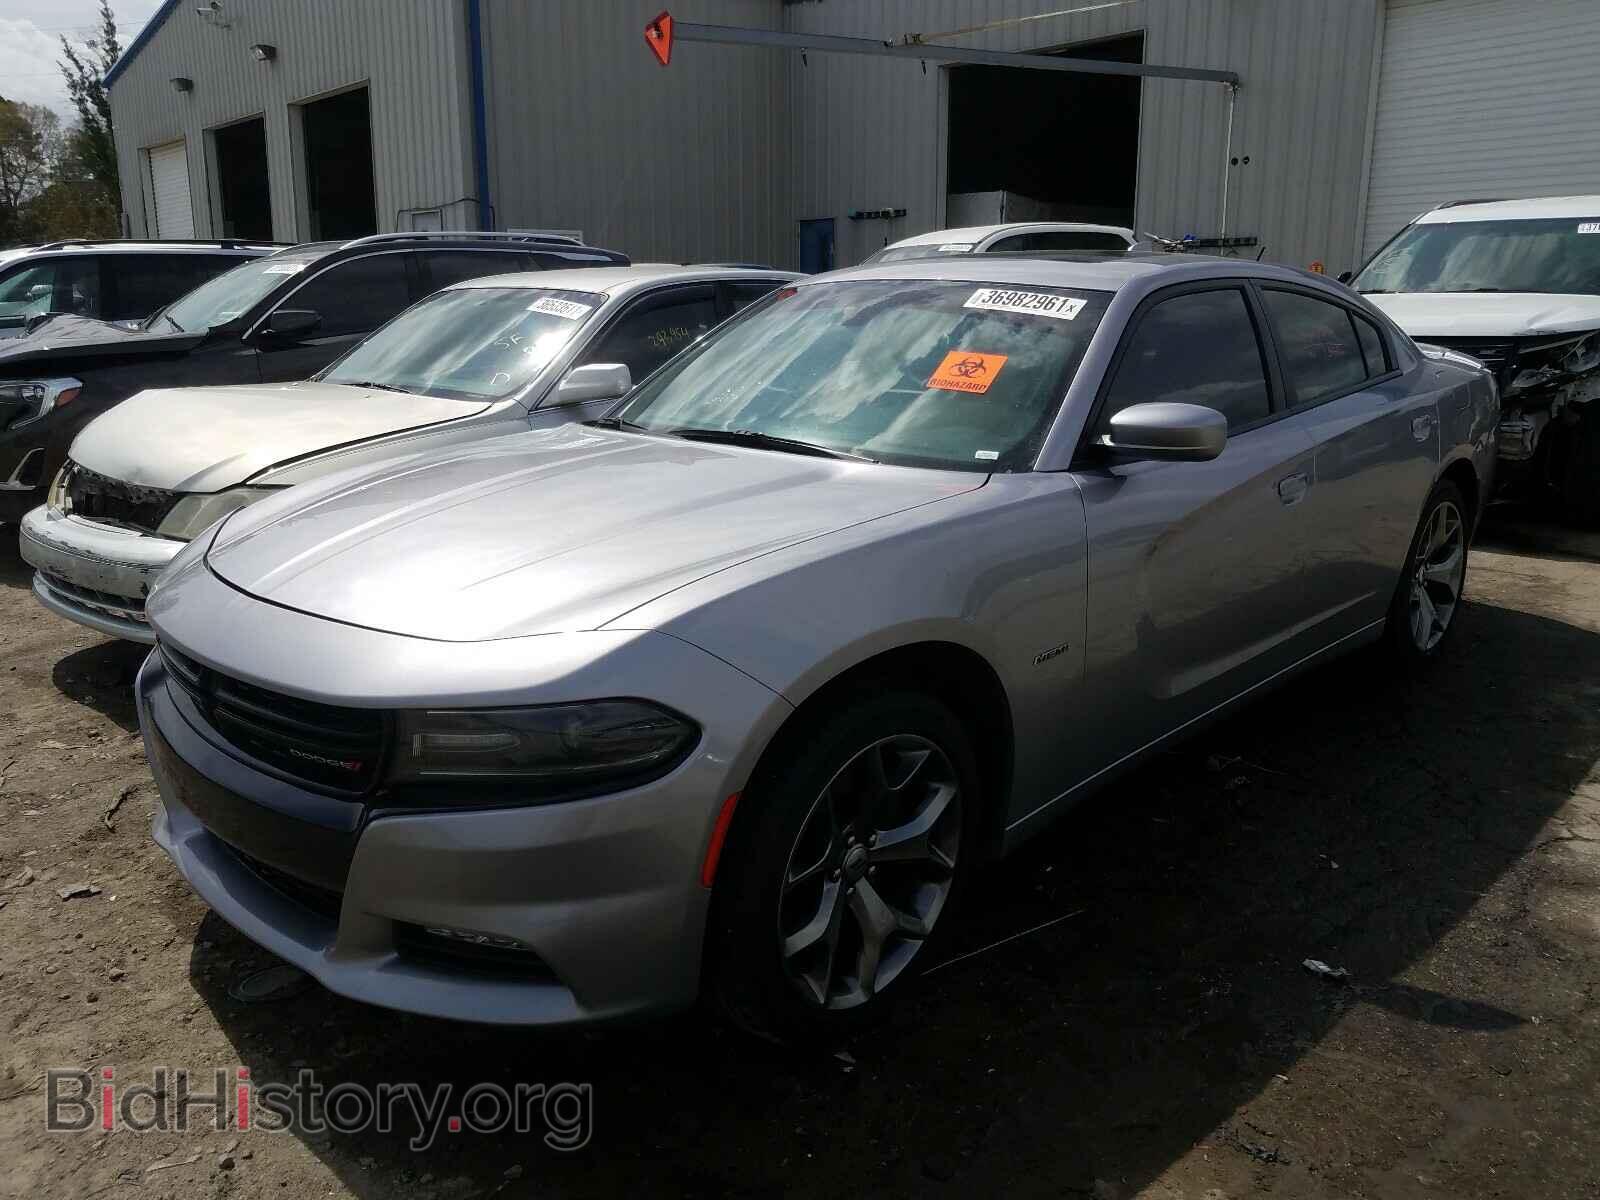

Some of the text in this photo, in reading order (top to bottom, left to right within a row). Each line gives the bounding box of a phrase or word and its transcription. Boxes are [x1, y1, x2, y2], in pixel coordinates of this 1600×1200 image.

[982, 289, 1068, 313] 36982961
[929, 378, 988, 391] BIOHAZARD
[290, 748, 352, 768] DODGE
